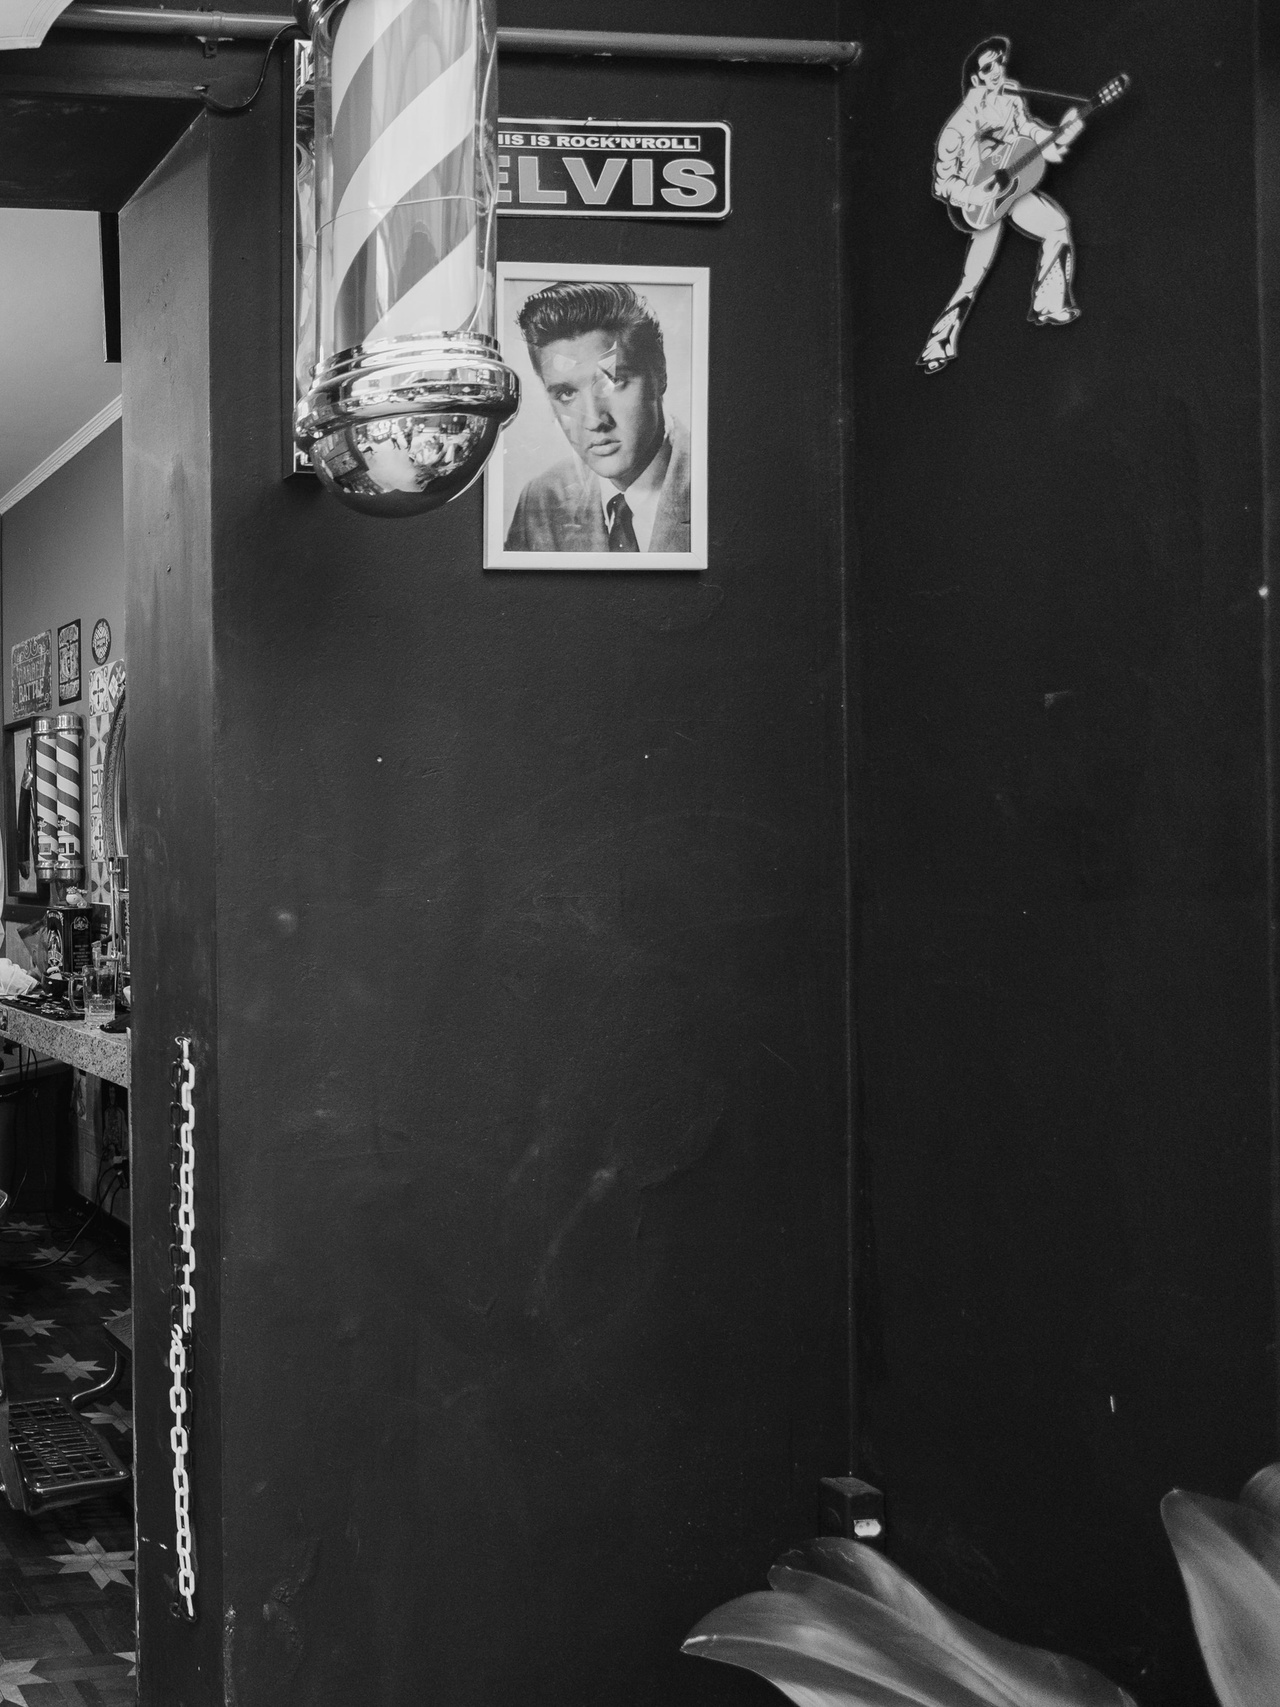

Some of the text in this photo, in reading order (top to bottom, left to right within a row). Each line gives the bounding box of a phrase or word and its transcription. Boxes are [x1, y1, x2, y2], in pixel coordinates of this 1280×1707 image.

[530, 135, 550, 146] IS
[557, 136, 697, 149] ROCK'N'ROLL
[18, 678, 44, 703] BATTLE
